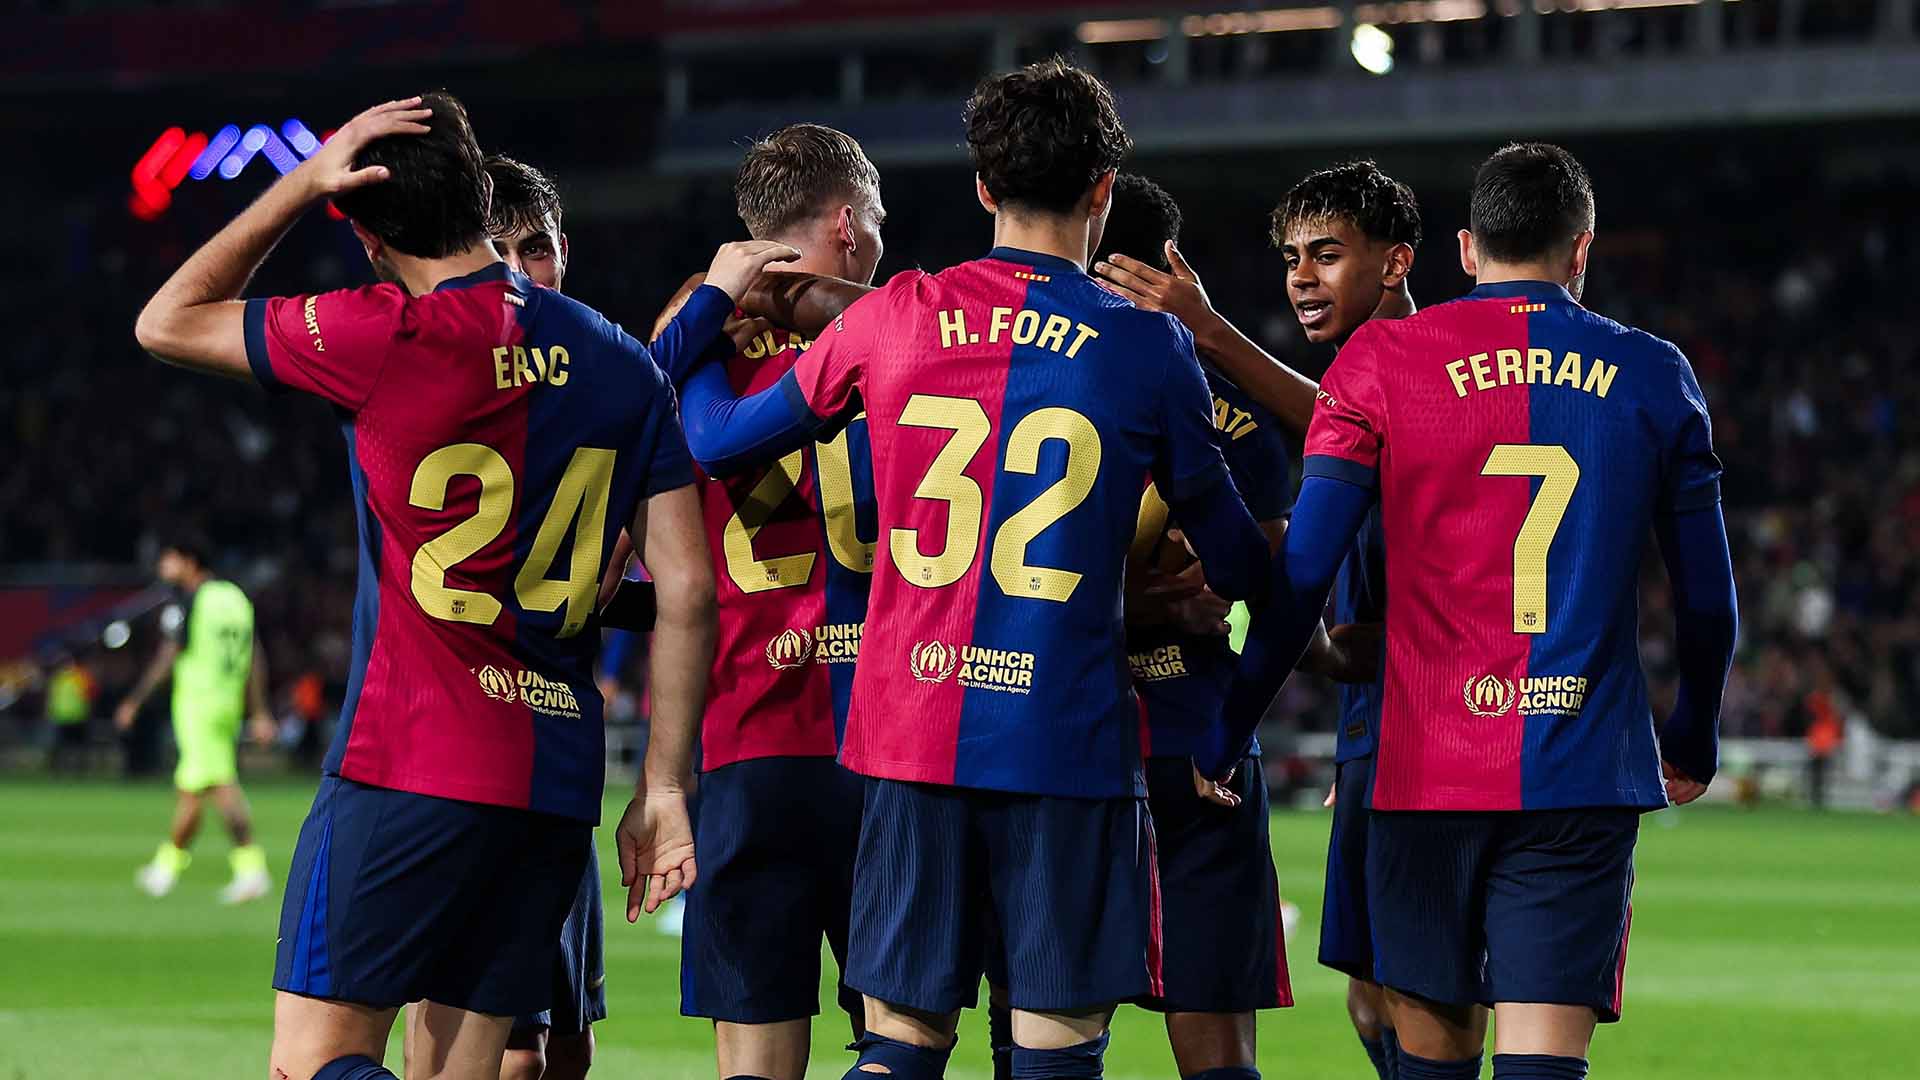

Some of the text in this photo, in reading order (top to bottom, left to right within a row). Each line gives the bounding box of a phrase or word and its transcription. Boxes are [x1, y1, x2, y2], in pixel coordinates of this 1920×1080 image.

[938, 306, 1100, 359] H. FORT
[492, 345, 570, 390] ERIC
[1445, 348, 1619, 399] FERRAN
[1211, 393, 1258, 440] ATI
[889, 394, 1102, 603] 32
[408, 442, 617, 639] 24
[1480, 444, 1580, 634] 7
[957, 662, 1033, 687] ACNUR
[961, 645, 1035, 670] UNHCR
[520, 687, 580, 712] ACNUR
[957, 678, 1031, 696] The UN Refugee Agency
[1517, 691, 1584, 710] ACNUR
[1519, 675, 1588, 694] UNHCR
[1529, 708, 1539, 716] UN
[1539, 707, 1565, 716] Refugee
